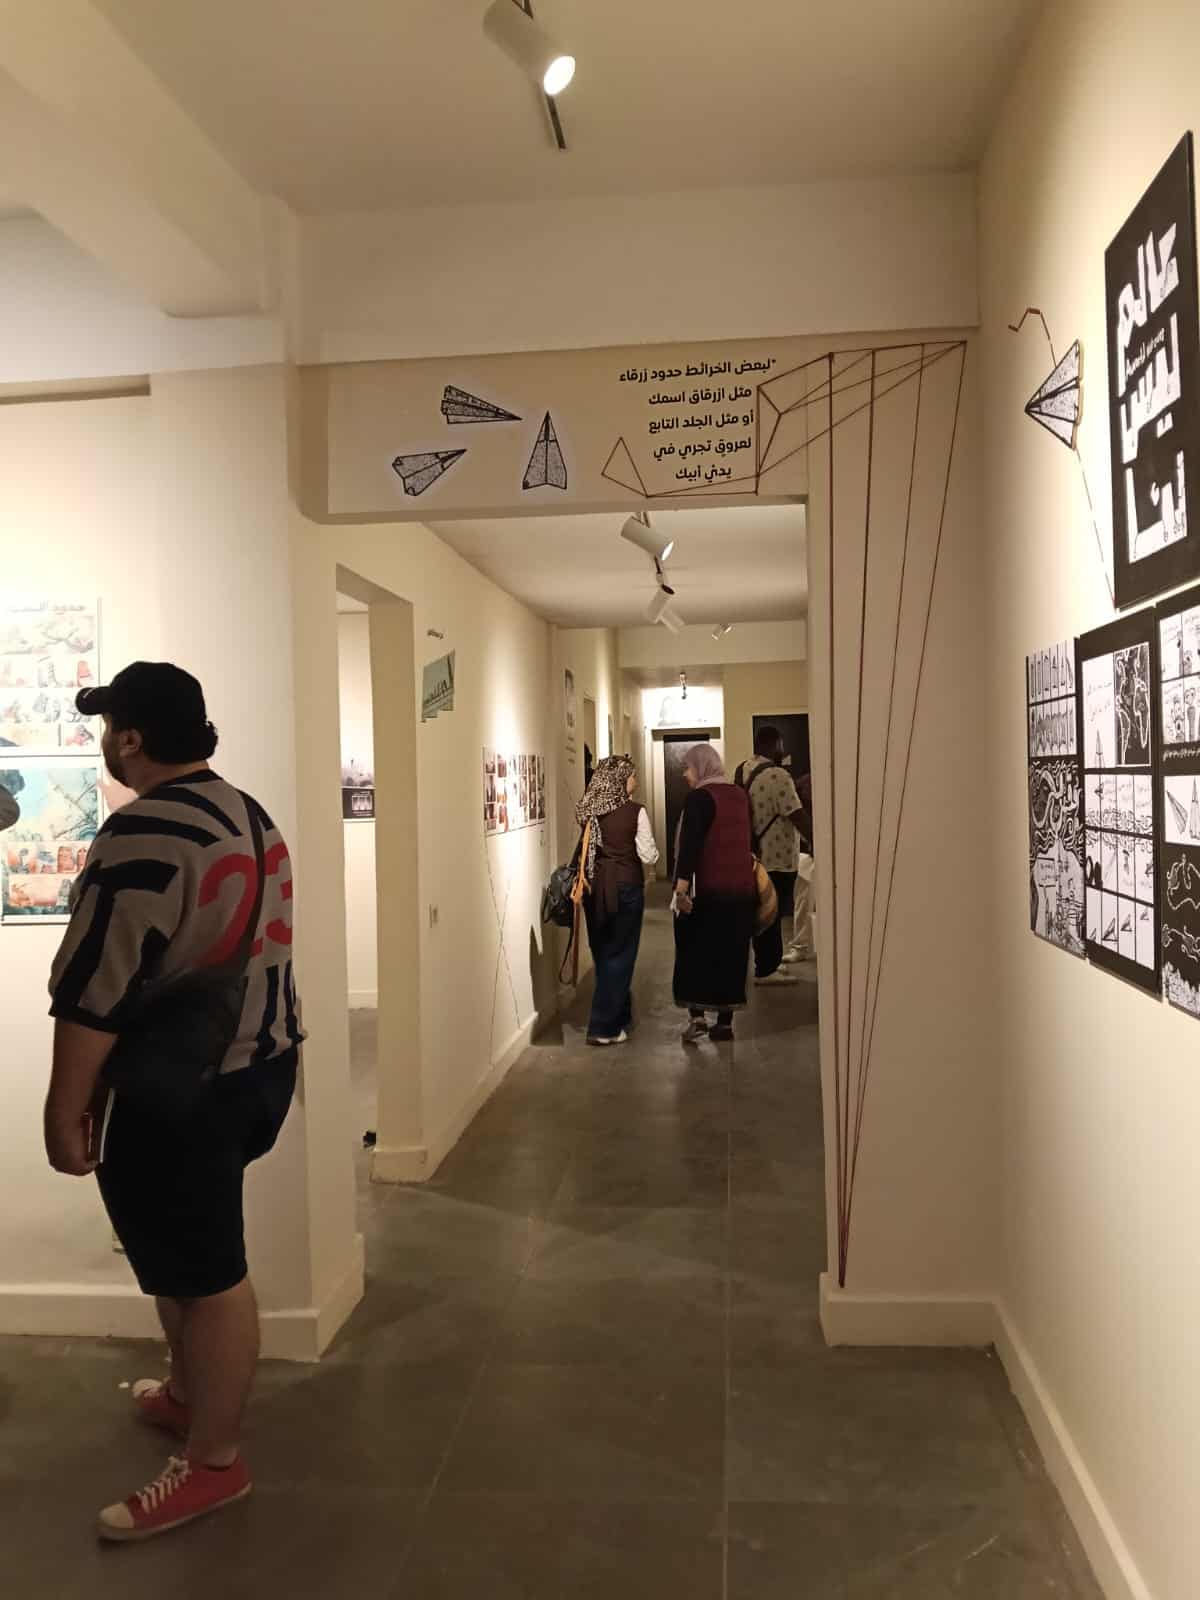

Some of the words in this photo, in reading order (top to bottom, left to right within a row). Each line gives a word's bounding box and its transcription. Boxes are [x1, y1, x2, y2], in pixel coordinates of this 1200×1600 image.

[619, 368, 648, 383] زرقاء
[651, 369, 682, 381] حدود
[685, 361, 731, 378] الخرائط
[648, 391, 685, 405] اسمك
[649, 416, 679, 434] التابع
[682, 414, 712, 430] الجلد
[715, 413, 738, 428] مثل
[742, 410, 754, 426] أو
[653, 443, 675, 461] في
[678, 440, 711, 460] تجري
[675, 465, 701, 482] أبيك
